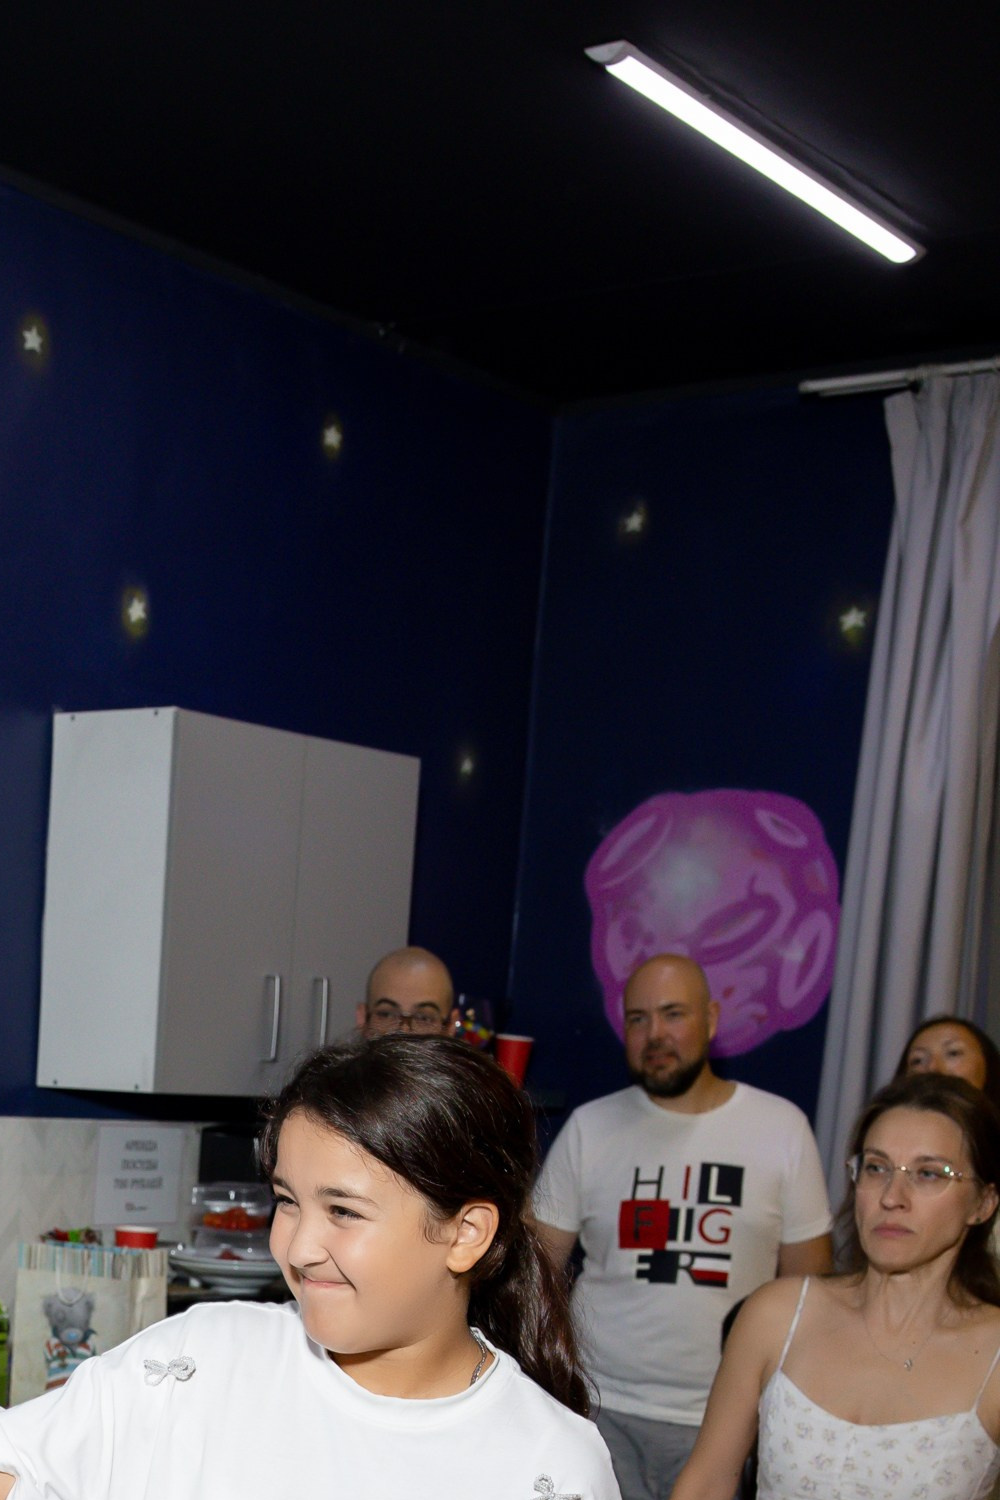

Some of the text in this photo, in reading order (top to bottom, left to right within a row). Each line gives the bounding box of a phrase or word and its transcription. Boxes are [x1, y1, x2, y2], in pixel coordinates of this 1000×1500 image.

[631, 1164, 733, 1203] HIL
[633, 1206, 734, 1245] FIG
[632, 1249, 698, 1286] ER
